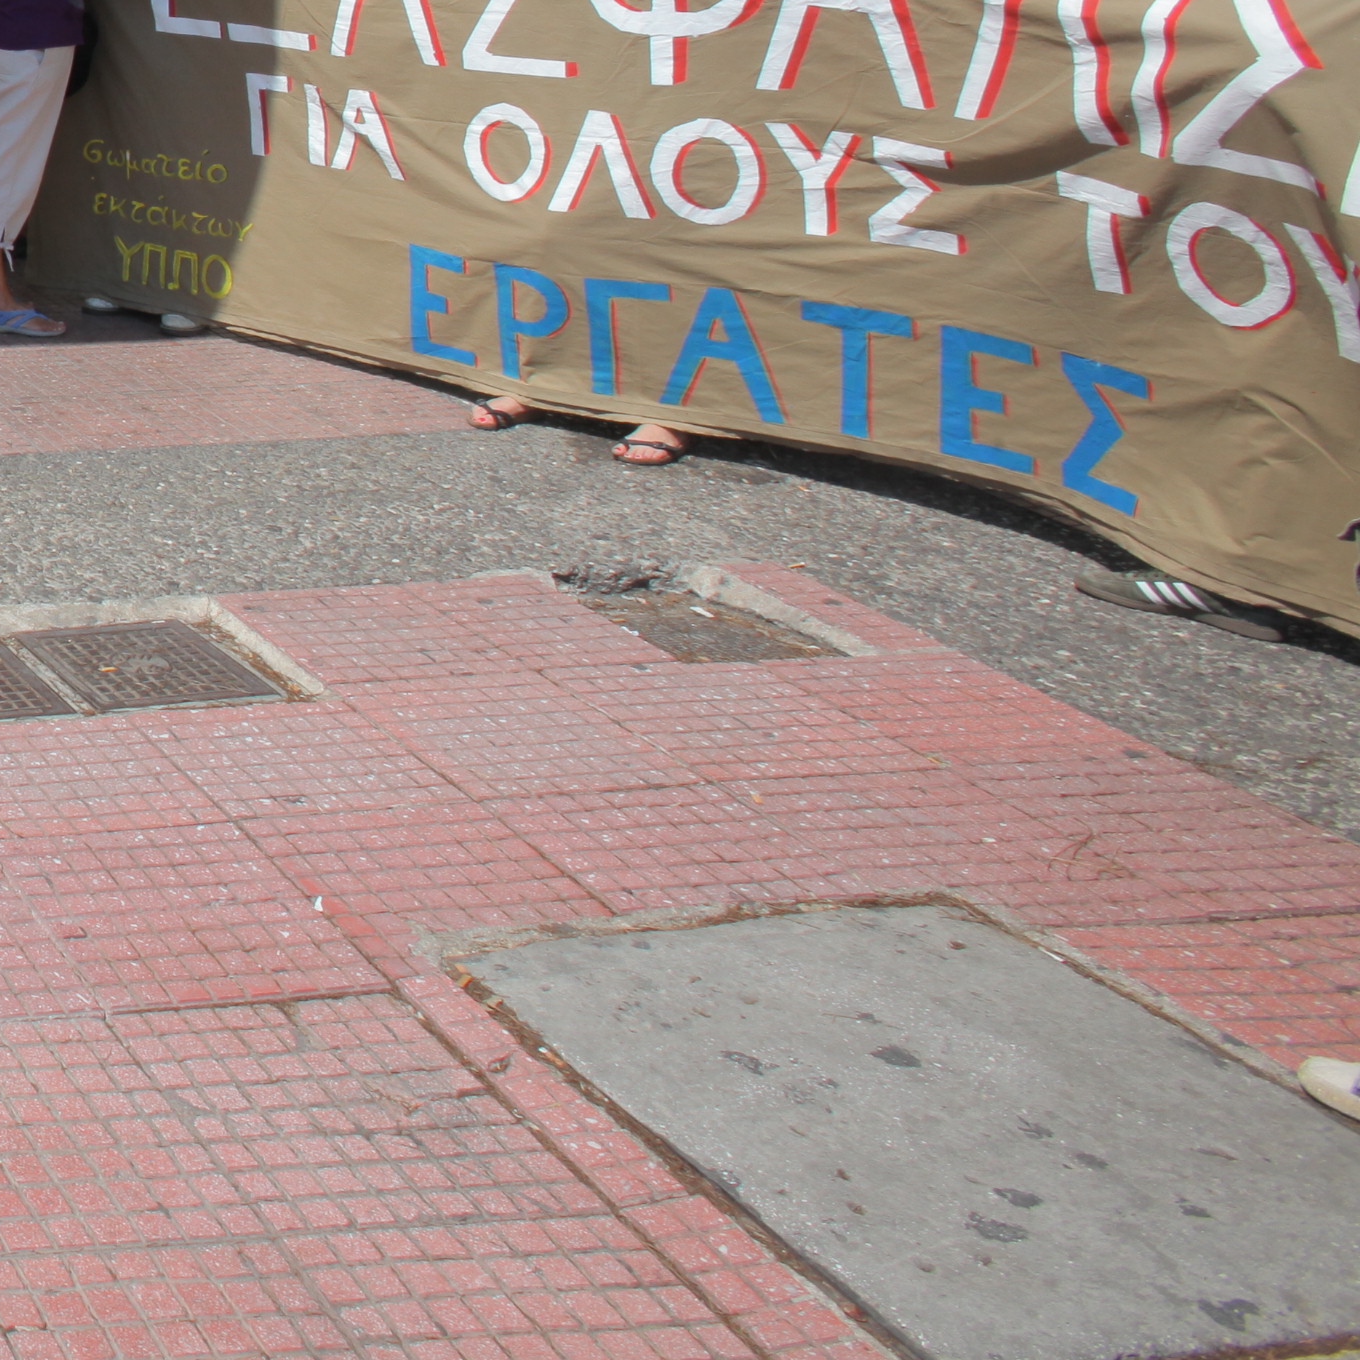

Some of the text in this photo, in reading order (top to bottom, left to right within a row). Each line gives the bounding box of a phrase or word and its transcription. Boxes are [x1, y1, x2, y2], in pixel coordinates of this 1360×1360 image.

[246, 72, 407, 181] ΓΙΑ
[463, 103, 968, 256] ΟΛΟΥΣ
[408, 243, 1152, 517] ΕΡΓΑΤΕΣ
